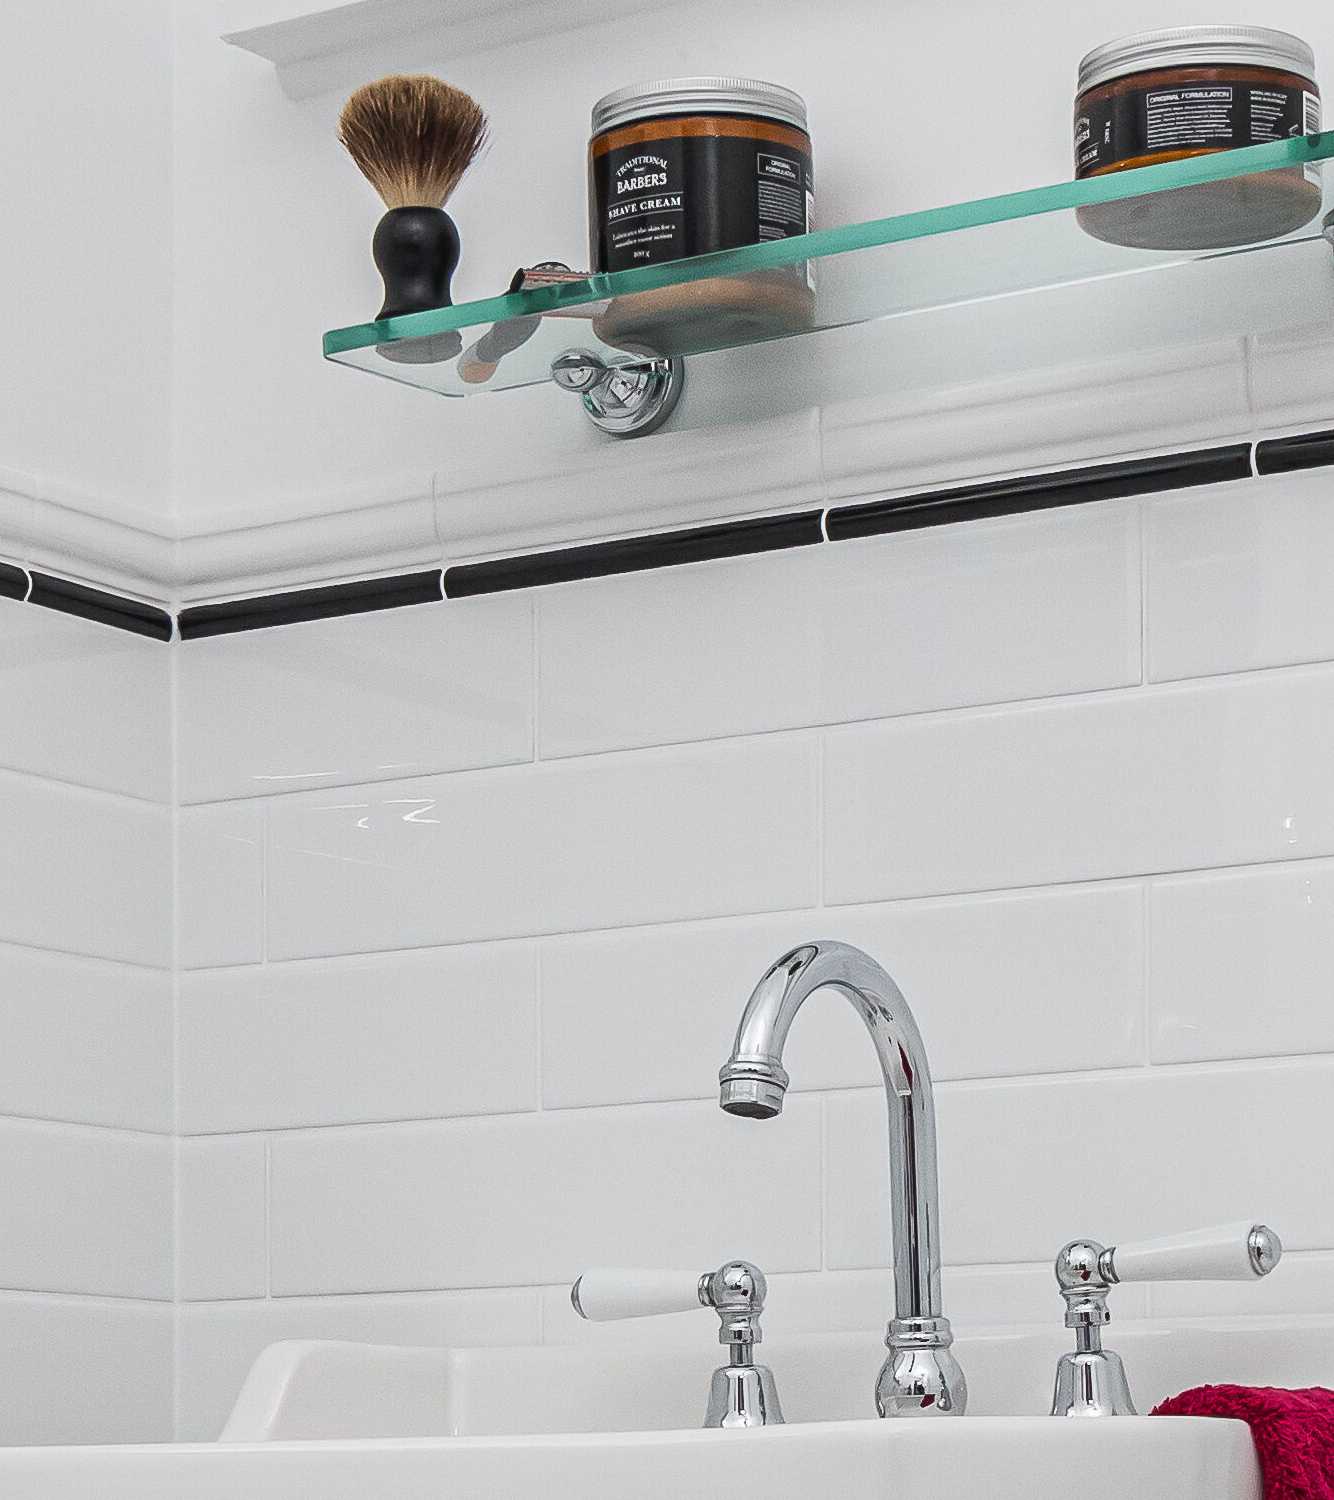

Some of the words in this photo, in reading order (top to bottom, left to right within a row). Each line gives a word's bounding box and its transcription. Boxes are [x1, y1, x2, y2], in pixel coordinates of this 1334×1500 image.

[616, 156, 667, 176] TRADITIONAL
[617, 173, 667, 194] BARBERS
[608, 203, 637, 219] SHAVE
[640, 197, 681, 210] CREAM
